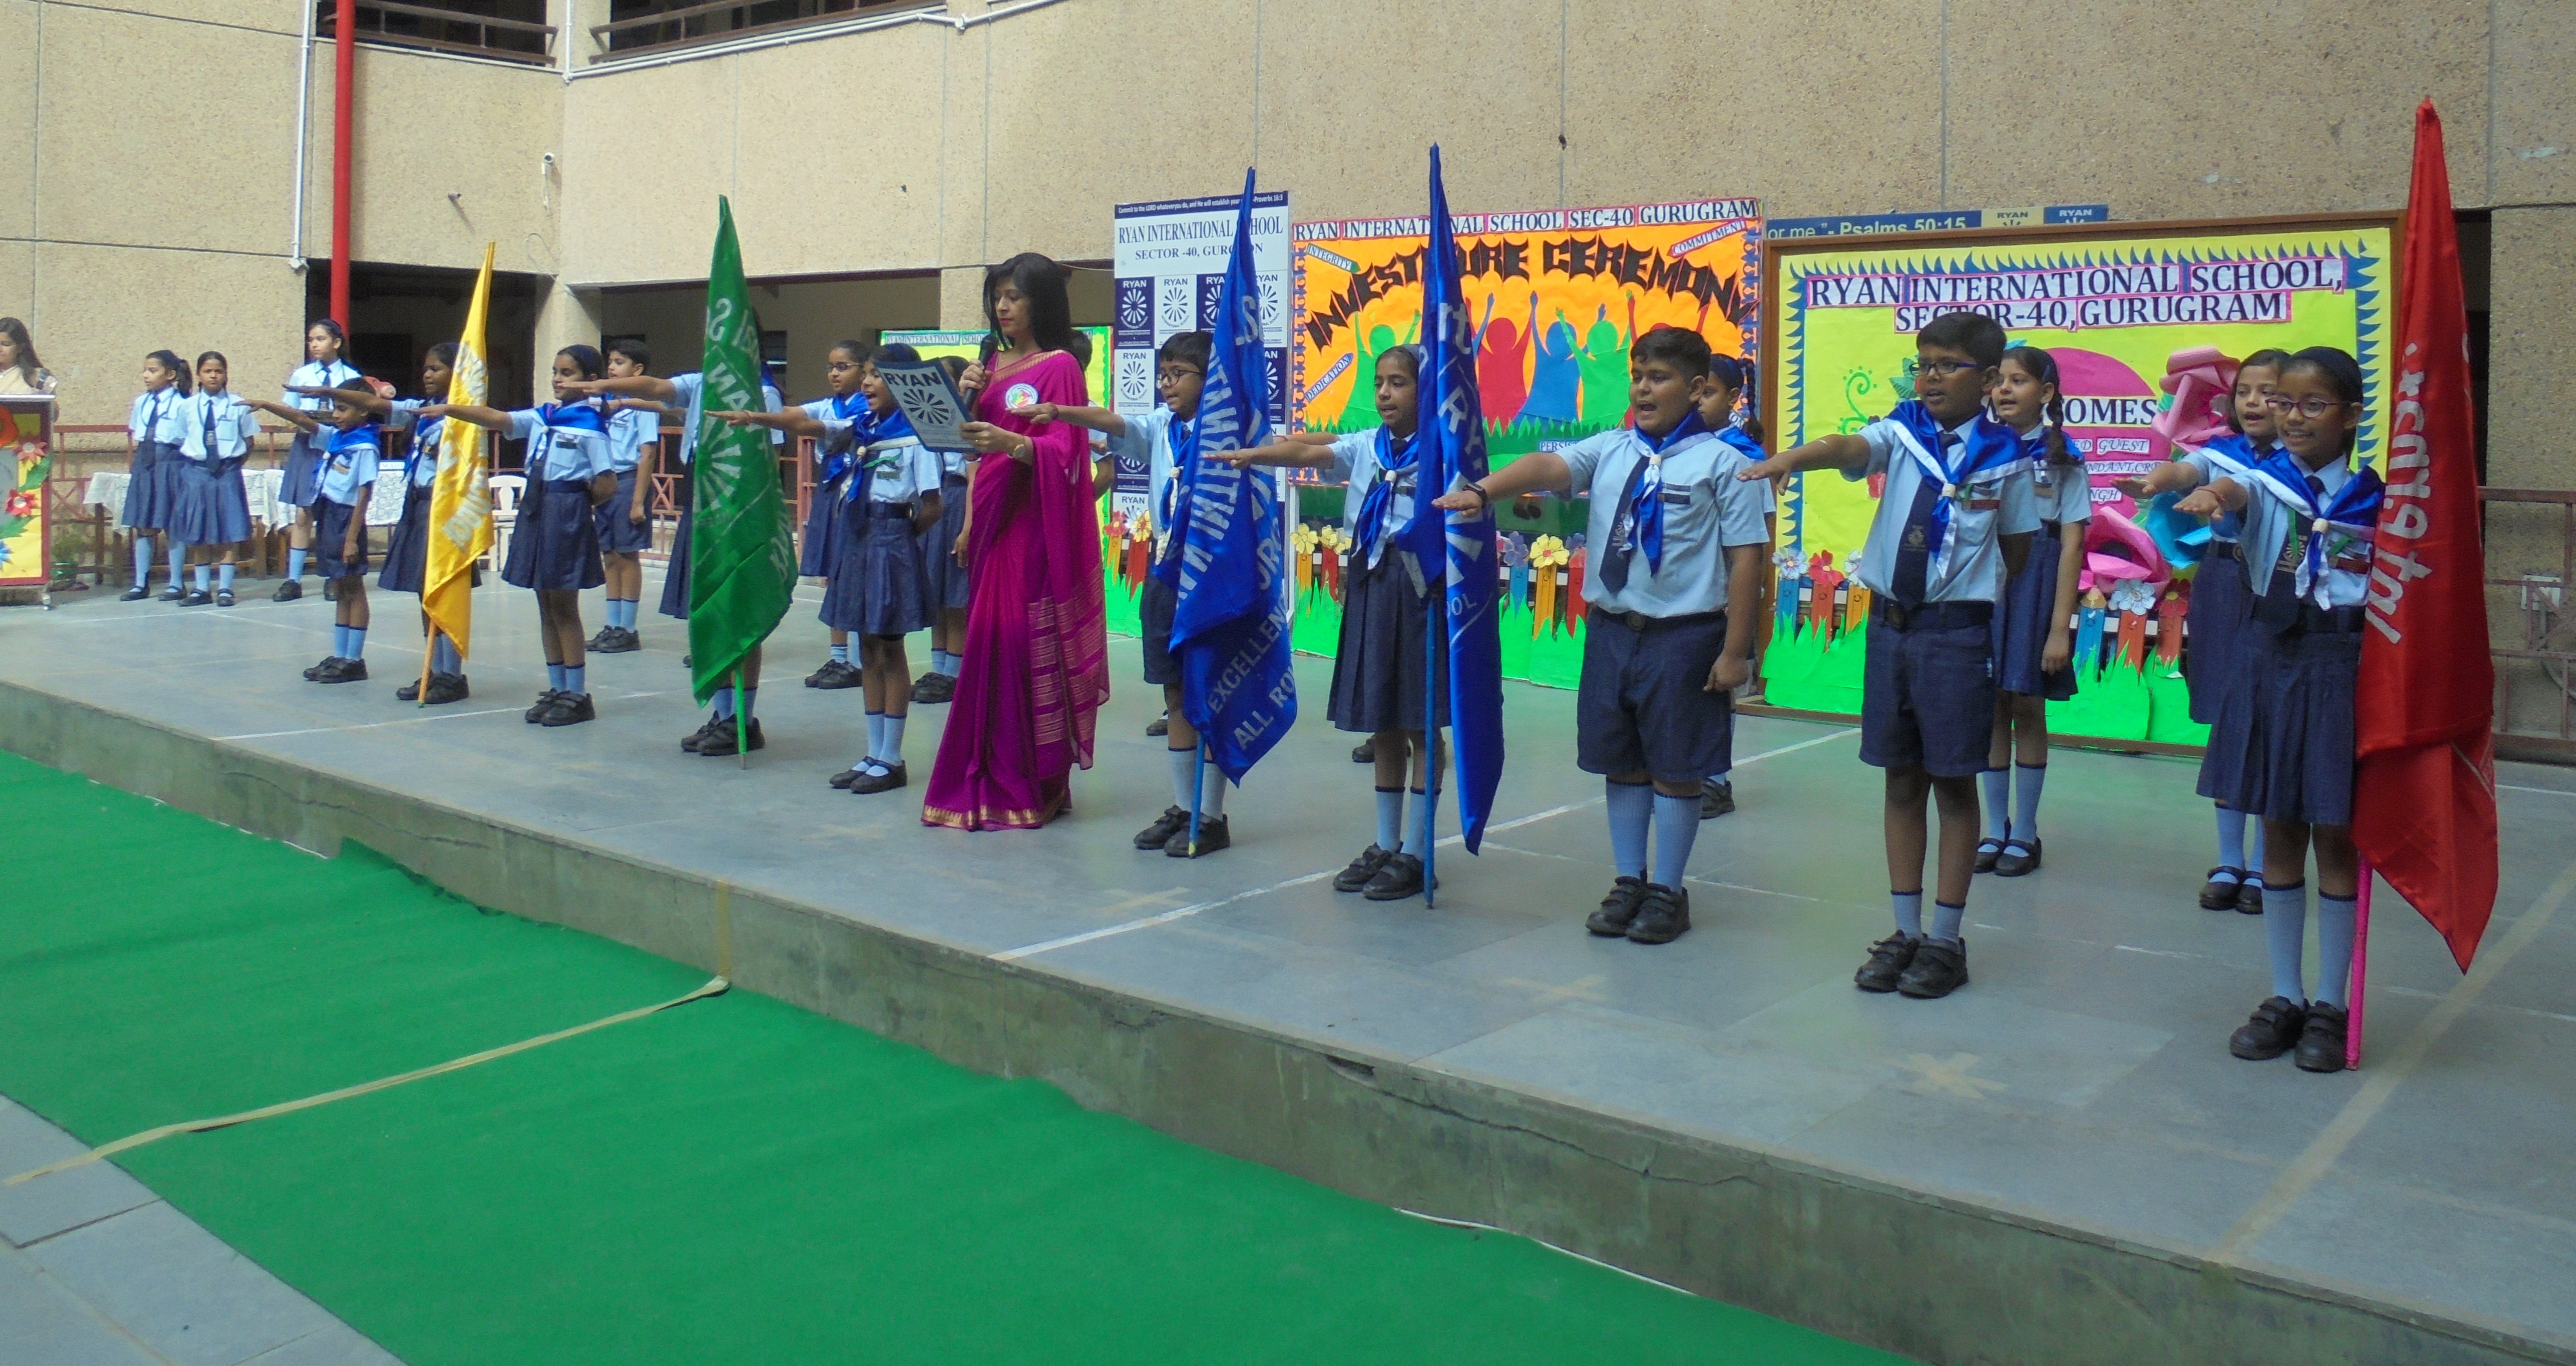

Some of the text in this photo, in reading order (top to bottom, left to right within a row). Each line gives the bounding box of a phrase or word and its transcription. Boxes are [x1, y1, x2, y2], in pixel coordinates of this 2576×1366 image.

[1296, 200, 1757, 240] RYAN INTERNATNAL SCHOOL SEC-40 GURUGRAM
[2059, 208, 2092, 217] RYAN
[1119, 216, 1282, 244] RYAN INTERNATIONAL HOOL
[1840, 221, 1908, 235] Psalms
[1914, 216, 1967, 231] 50:15
[1672, 220, 1745, 254] COMMITMENT
[1136, 248, 1180, 260] SECTOR
[1308, 244, 1351, 270] INTEGRITY
[1123, 279, 1147, 288] RYAN
[1206, 276, 1225, 285] RYA
[1543, 232, 1760, 329] CEREMONY
[1811, 259, 2342, 306] RYAN INTERNATIONAL SCHOOL,
[2080, 292, 2282, 326] GURUGRAM
[902, 334, 959, 344] INTERNATIONAL
[883, 372, 942, 387] RYAN
[1306, 355, 1350, 401] DEDICATION
[2098, 439, 2148, 453] GUEST
[1122, 496, 1145, 504] RYAN
[1233, 710, 1274, 750] ALL
